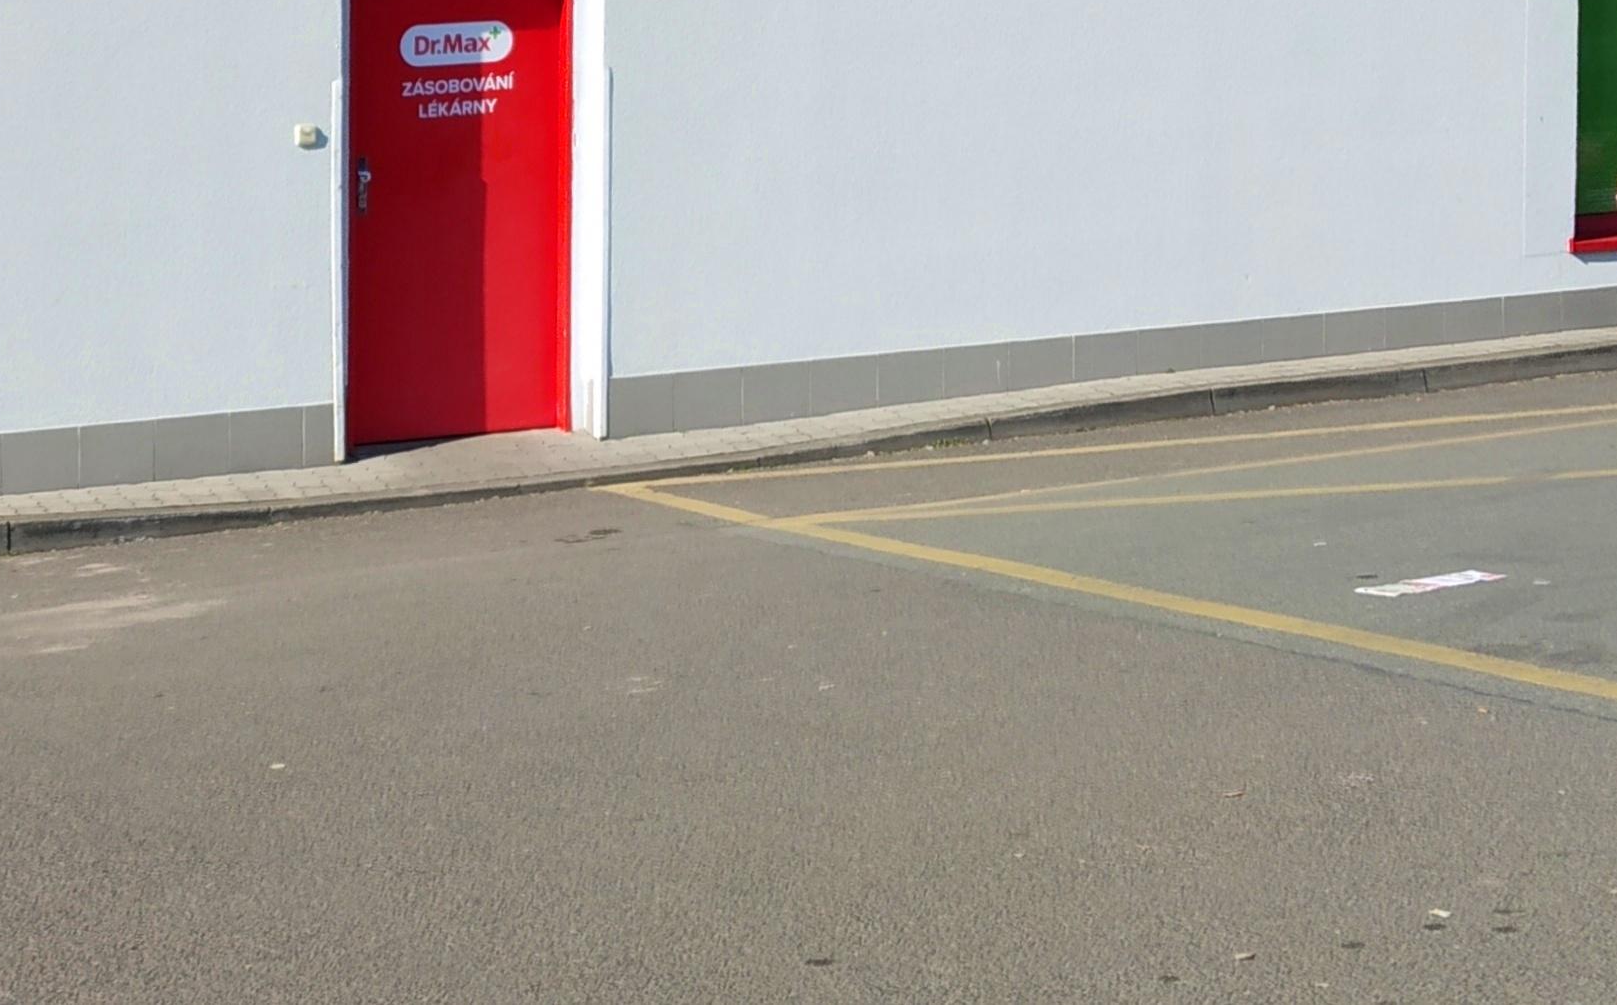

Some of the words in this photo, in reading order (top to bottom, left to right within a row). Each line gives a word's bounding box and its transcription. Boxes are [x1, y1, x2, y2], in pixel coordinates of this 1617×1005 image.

[414, 33, 491, 57] Dr.Max
[401, 70, 515, 97] ZÁSOBOVÁNÍ
[418, 97, 498, 119] LÉKÁRNY
